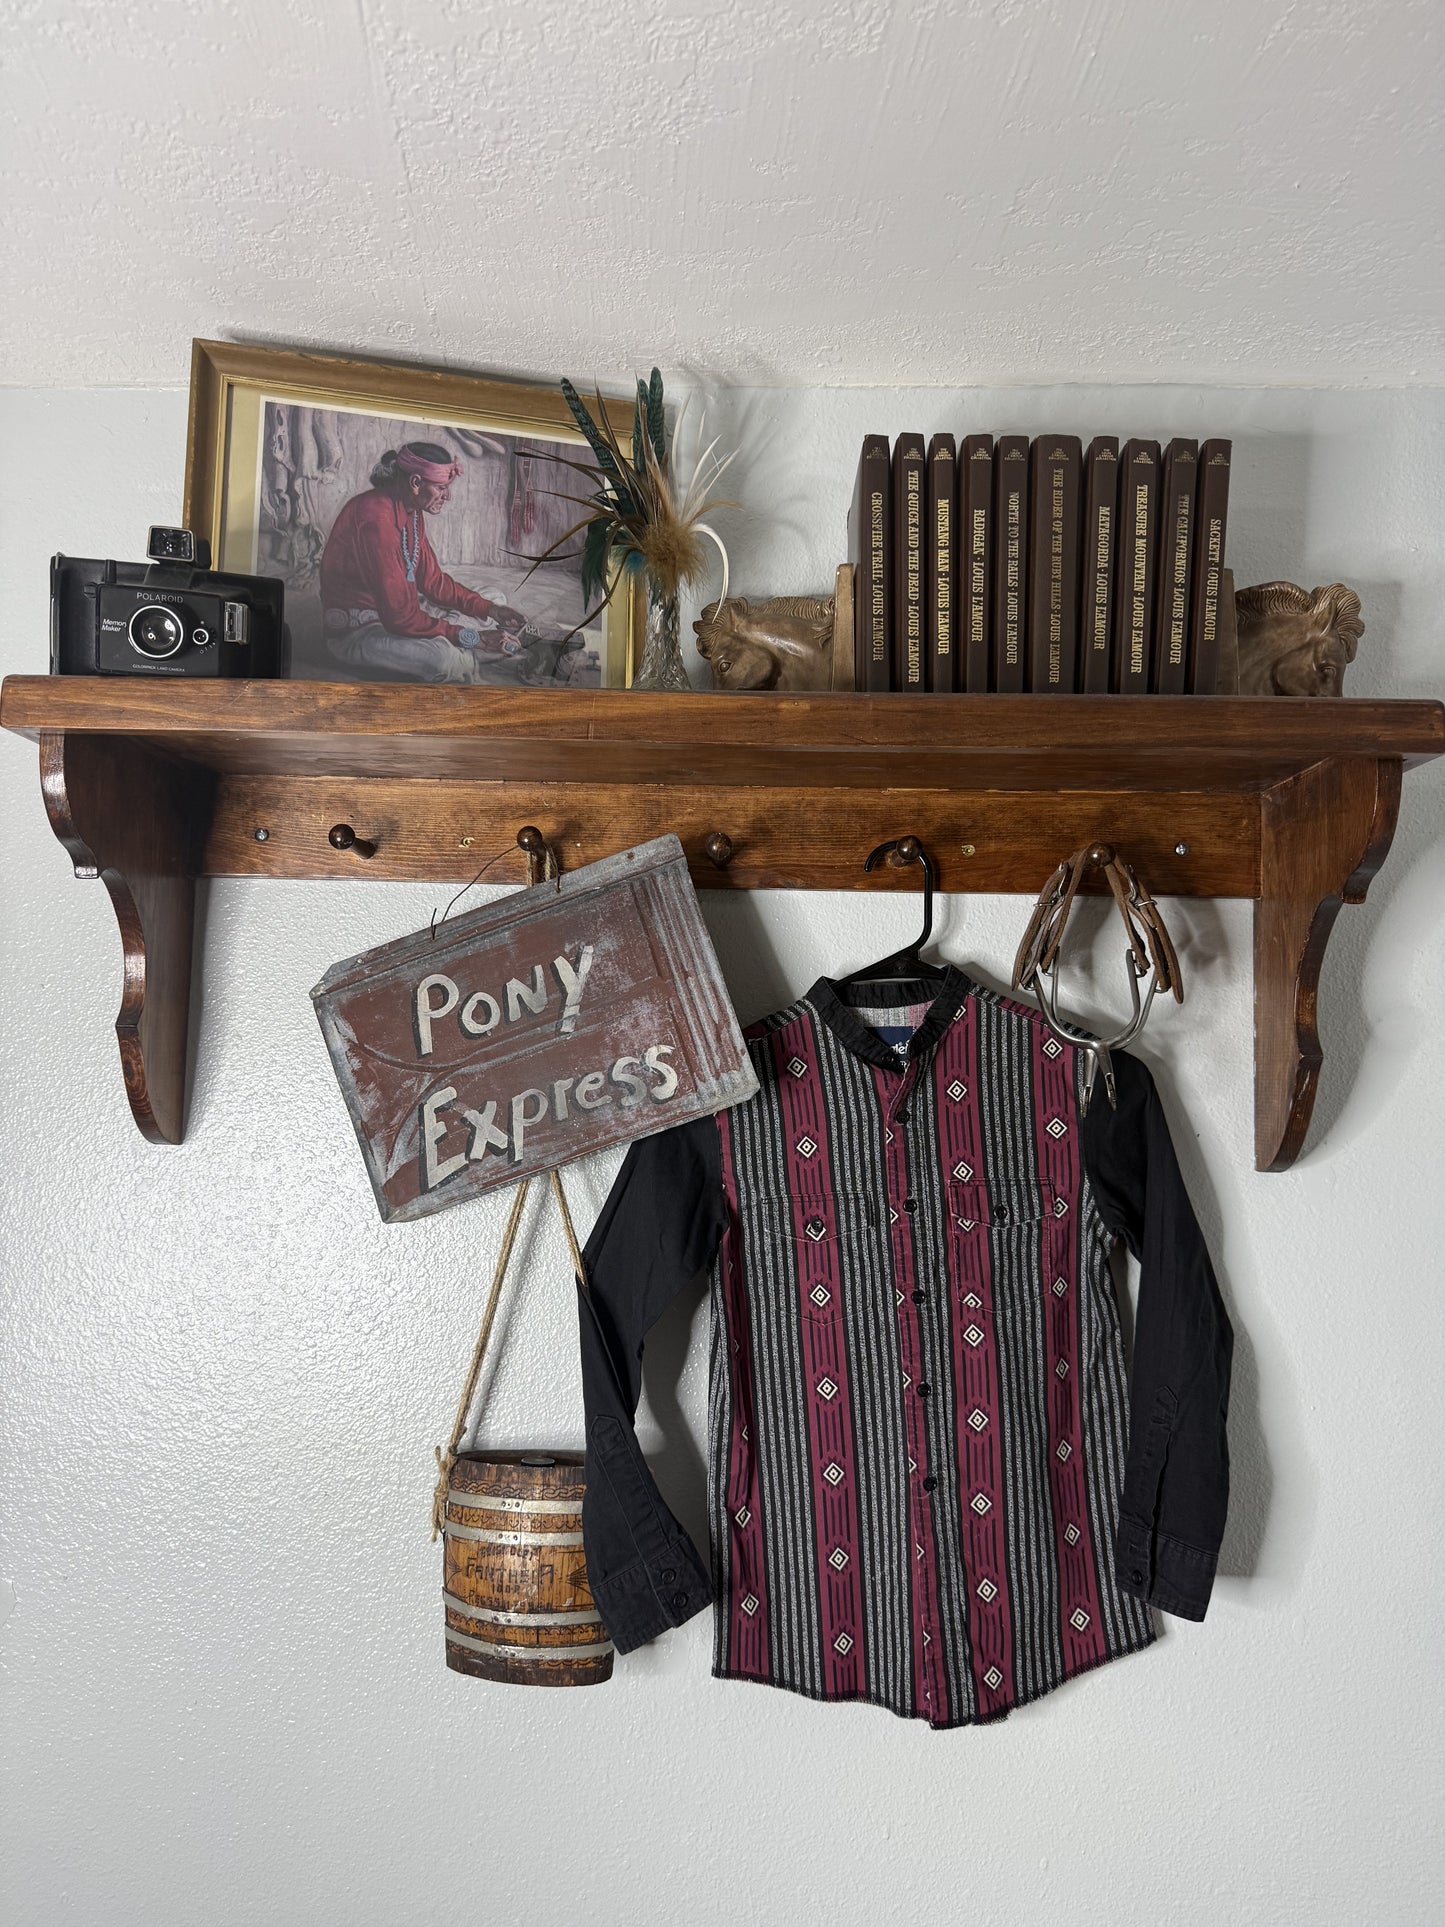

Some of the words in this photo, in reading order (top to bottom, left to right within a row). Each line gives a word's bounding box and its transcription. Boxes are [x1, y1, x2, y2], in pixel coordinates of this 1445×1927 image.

[908, 471, 919, 491] THE
[1053, 469, 1063, 487] THE
[907, 493, 919, 525] QUICK
[1008, 492, 1019, 523] NORTH
[1052, 490, 1063, 518] RIDER
[1135, 485, 1148, 536] TREASURE
[1177, 494, 1190, 515] THE
[872, 492, 883, 548] CROSSFIRE
[938, 499, 949, 546] MUSTANG
[973, 509, 985, 555] RADIGAN
[1008, 525, 1019, 538] TO
[1052, 520, 1063, 533] OF
[908, 526, 919, 548] AND
[1008, 540, 1019, 558] THE
[1052, 535, 1062, 553] THE
[1097, 506, 1110, 569] MATAGORDA
[1174, 516, 1189, 583] CALIFORNIOS
[1208, 519, 1221, 563] SACKETT
[872, 550, 883, 580] TRAIL
[908, 550, 919, 570] THE
[938, 550, 949, 572] MAN
[1007, 560, 1019, 588] RAILS
[1051, 556, 1062, 580] RUBY
[1134, 538, 1146, 593] MOUNTAIN
[908, 572, 919, 601] DEAD
[938, 578, 949, 608] LOUIS
[972, 562, 984, 593] LOUIS
[1096, 573, 1108, 604] LOUIS
[136, 592, 183, 603] POLAROID
[873, 584, 884, 615] LOUIS
[1007, 592, 1018, 621] LOUIS
[1051, 582, 1062, 610] HILLS
[1172, 588, 1185, 618] LOUIS
[908, 605, 919, 636] LOUIS
[971, 596, 984, 642] L'AMOUR
[1132, 596, 1145, 628] LOUIS
[1204, 598, 1217, 641] L'AMOUR
[873, 617, 884, 661] L'AMOUR
[938, 611, 949, 654] L'AMOUR
[1006, 623, 1018, 664] L'AMOUR
[1050, 614, 1061, 642] LOUIS
[1094, 606, 1107, 650] L'AMOUR
[1169, 620, 1183, 664] L'AMOUR
[908, 639, 919, 683] L'AMOUR
[1049, 644, 1061, 683] L'AMOUR
[1131, 629, 1144, 673] L'AMOUR
[420, 1045, 678, 1194] Express
